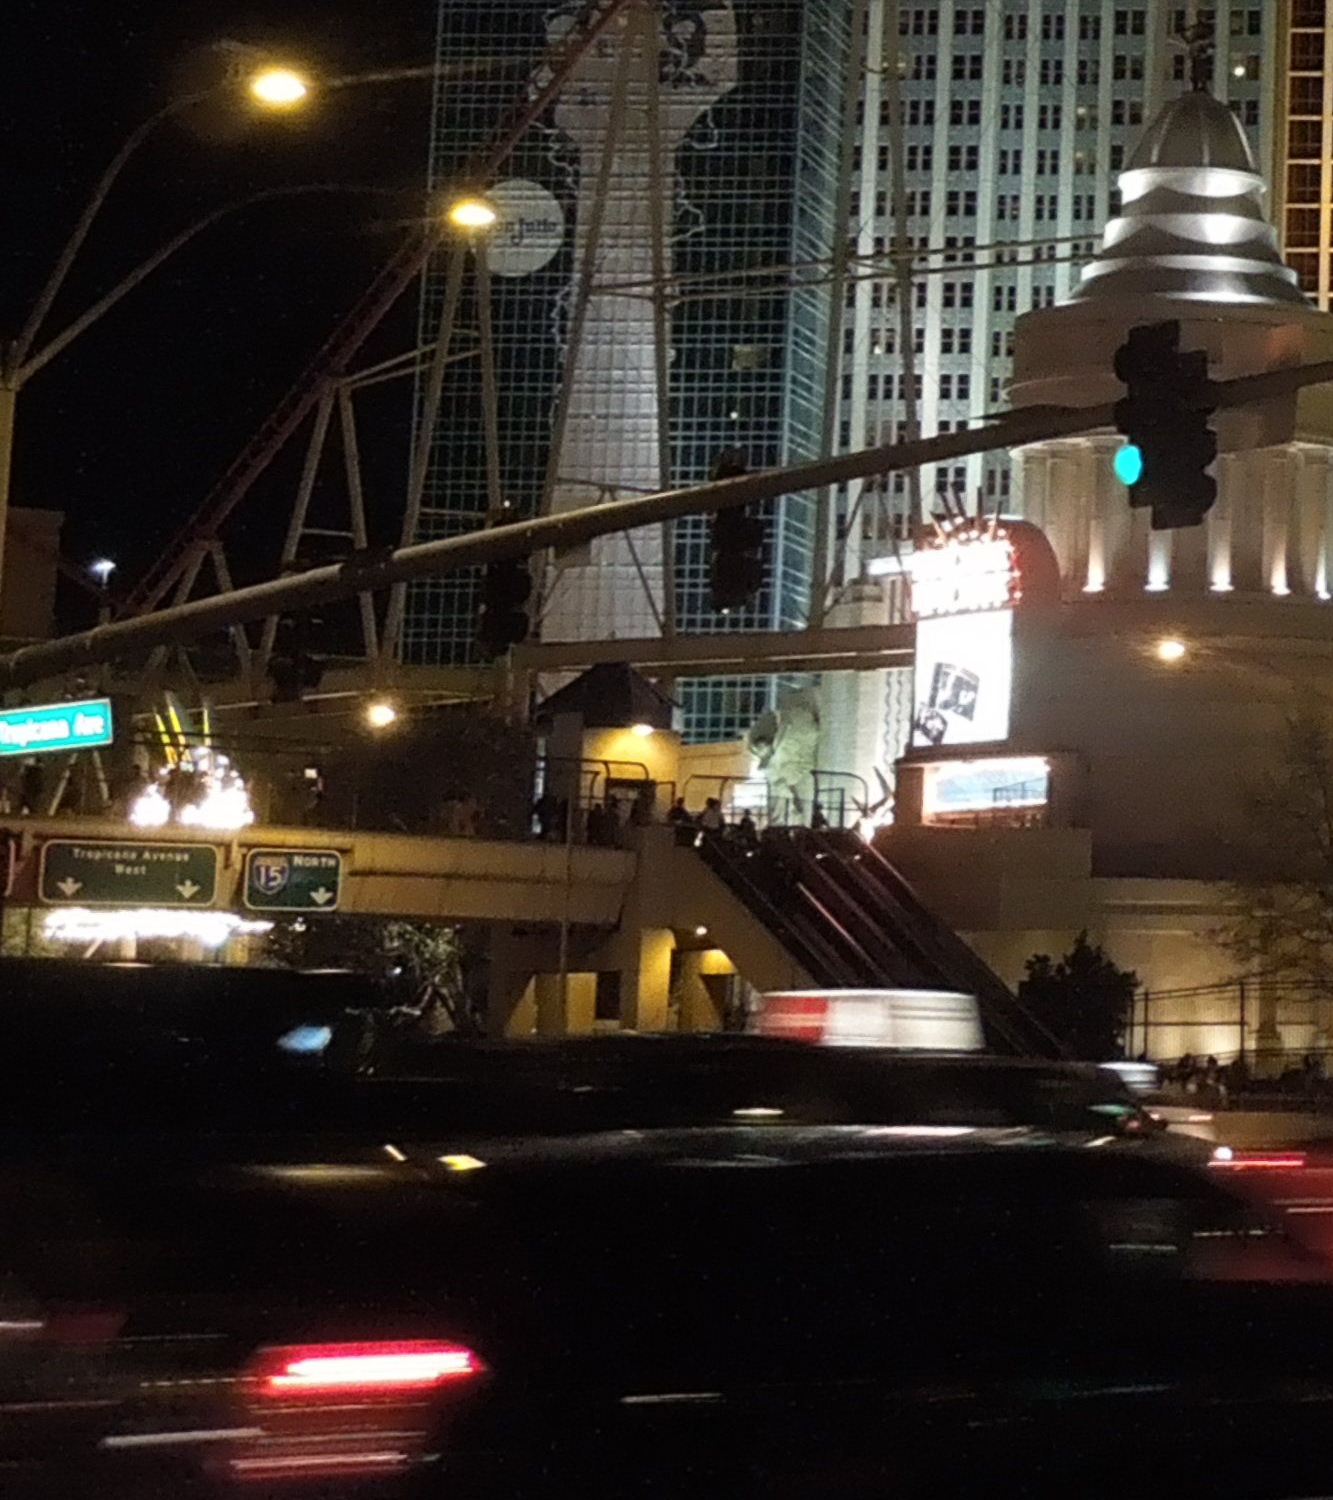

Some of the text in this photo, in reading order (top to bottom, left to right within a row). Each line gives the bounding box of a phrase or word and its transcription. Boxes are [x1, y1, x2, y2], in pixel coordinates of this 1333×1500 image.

[73, 849, 190, 862] Tropicana Avenue
[293, 855, 337, 867] NORTH
[114, 864, 147, 876] West
[260, 865, 282, 887] 15
